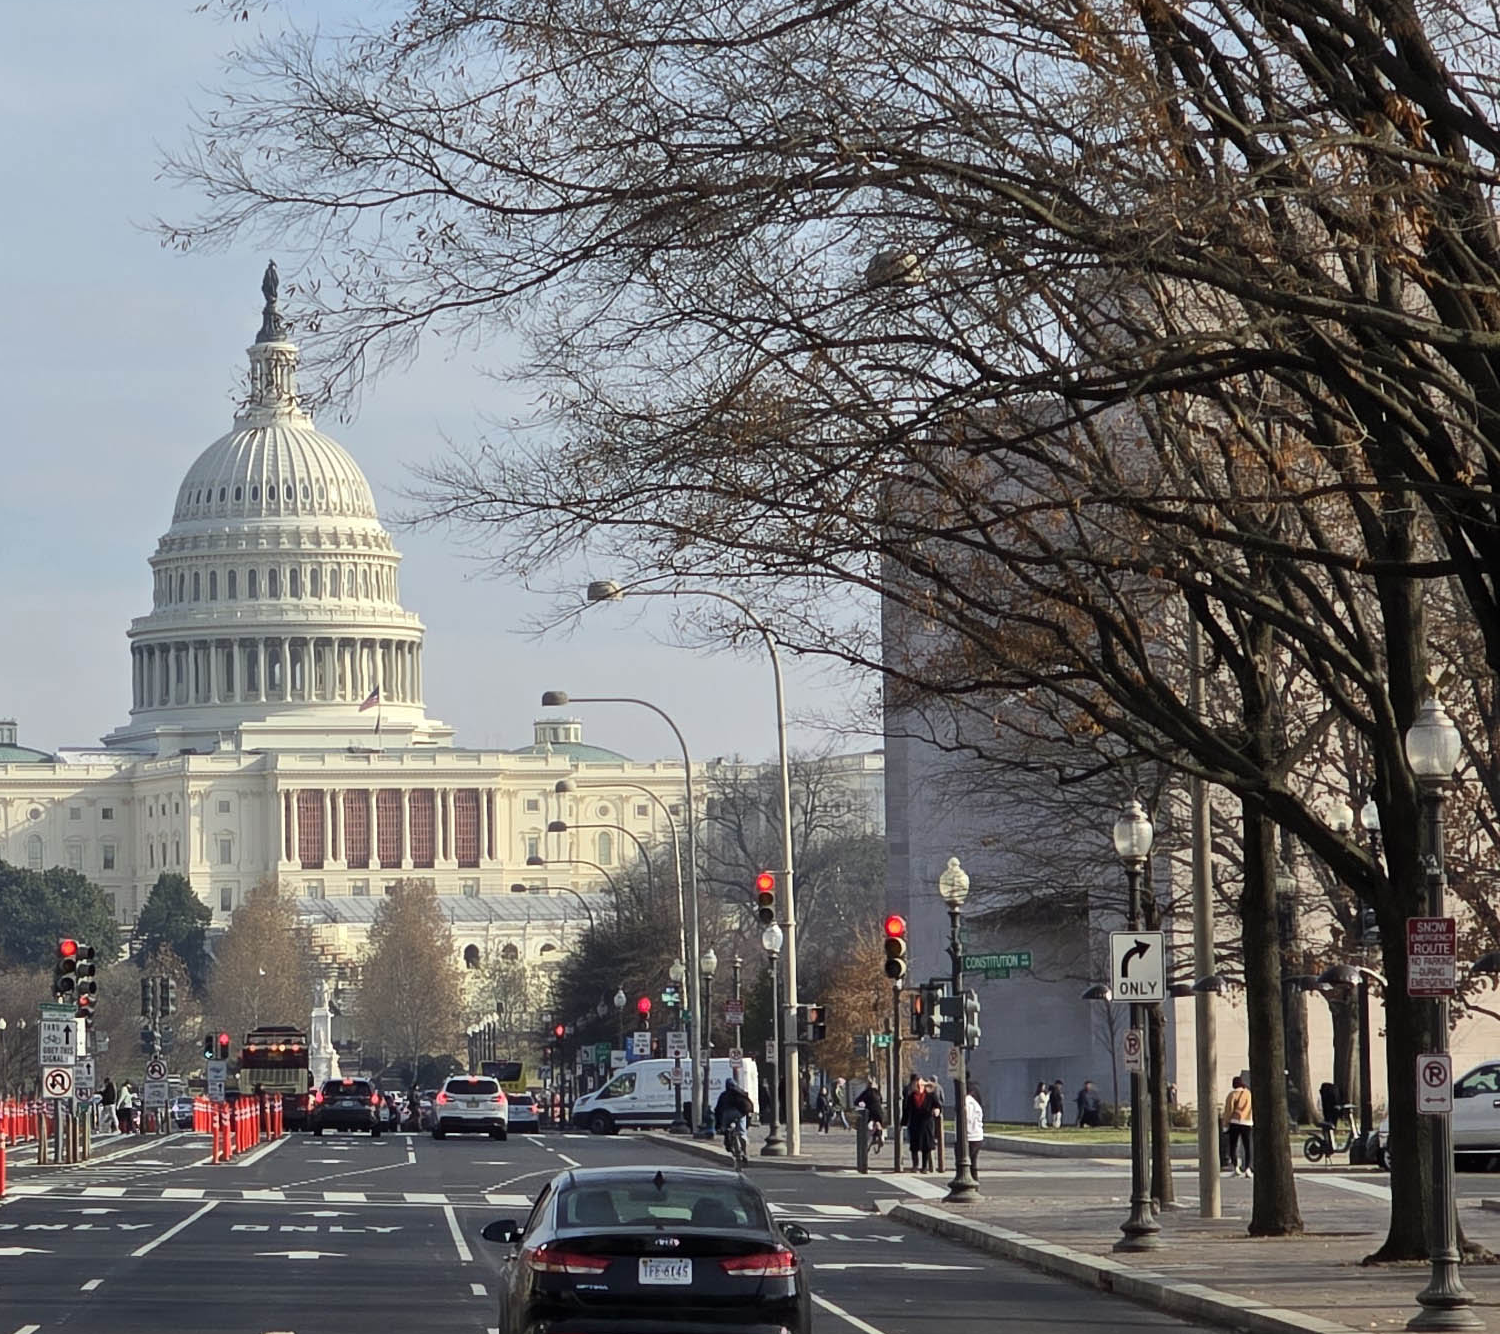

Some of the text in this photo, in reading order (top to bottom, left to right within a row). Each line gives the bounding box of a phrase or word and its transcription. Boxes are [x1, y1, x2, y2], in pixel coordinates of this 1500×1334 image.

[1416, 922, 1447, 933] SNOW
[1413, 943, 1451, 954] ROUTE
[965, 954, 1019, 970] CONSTITUTION
[1119, 981, 1158, 996] ONLY
[230, 1223, 405, 1233] ONLY
